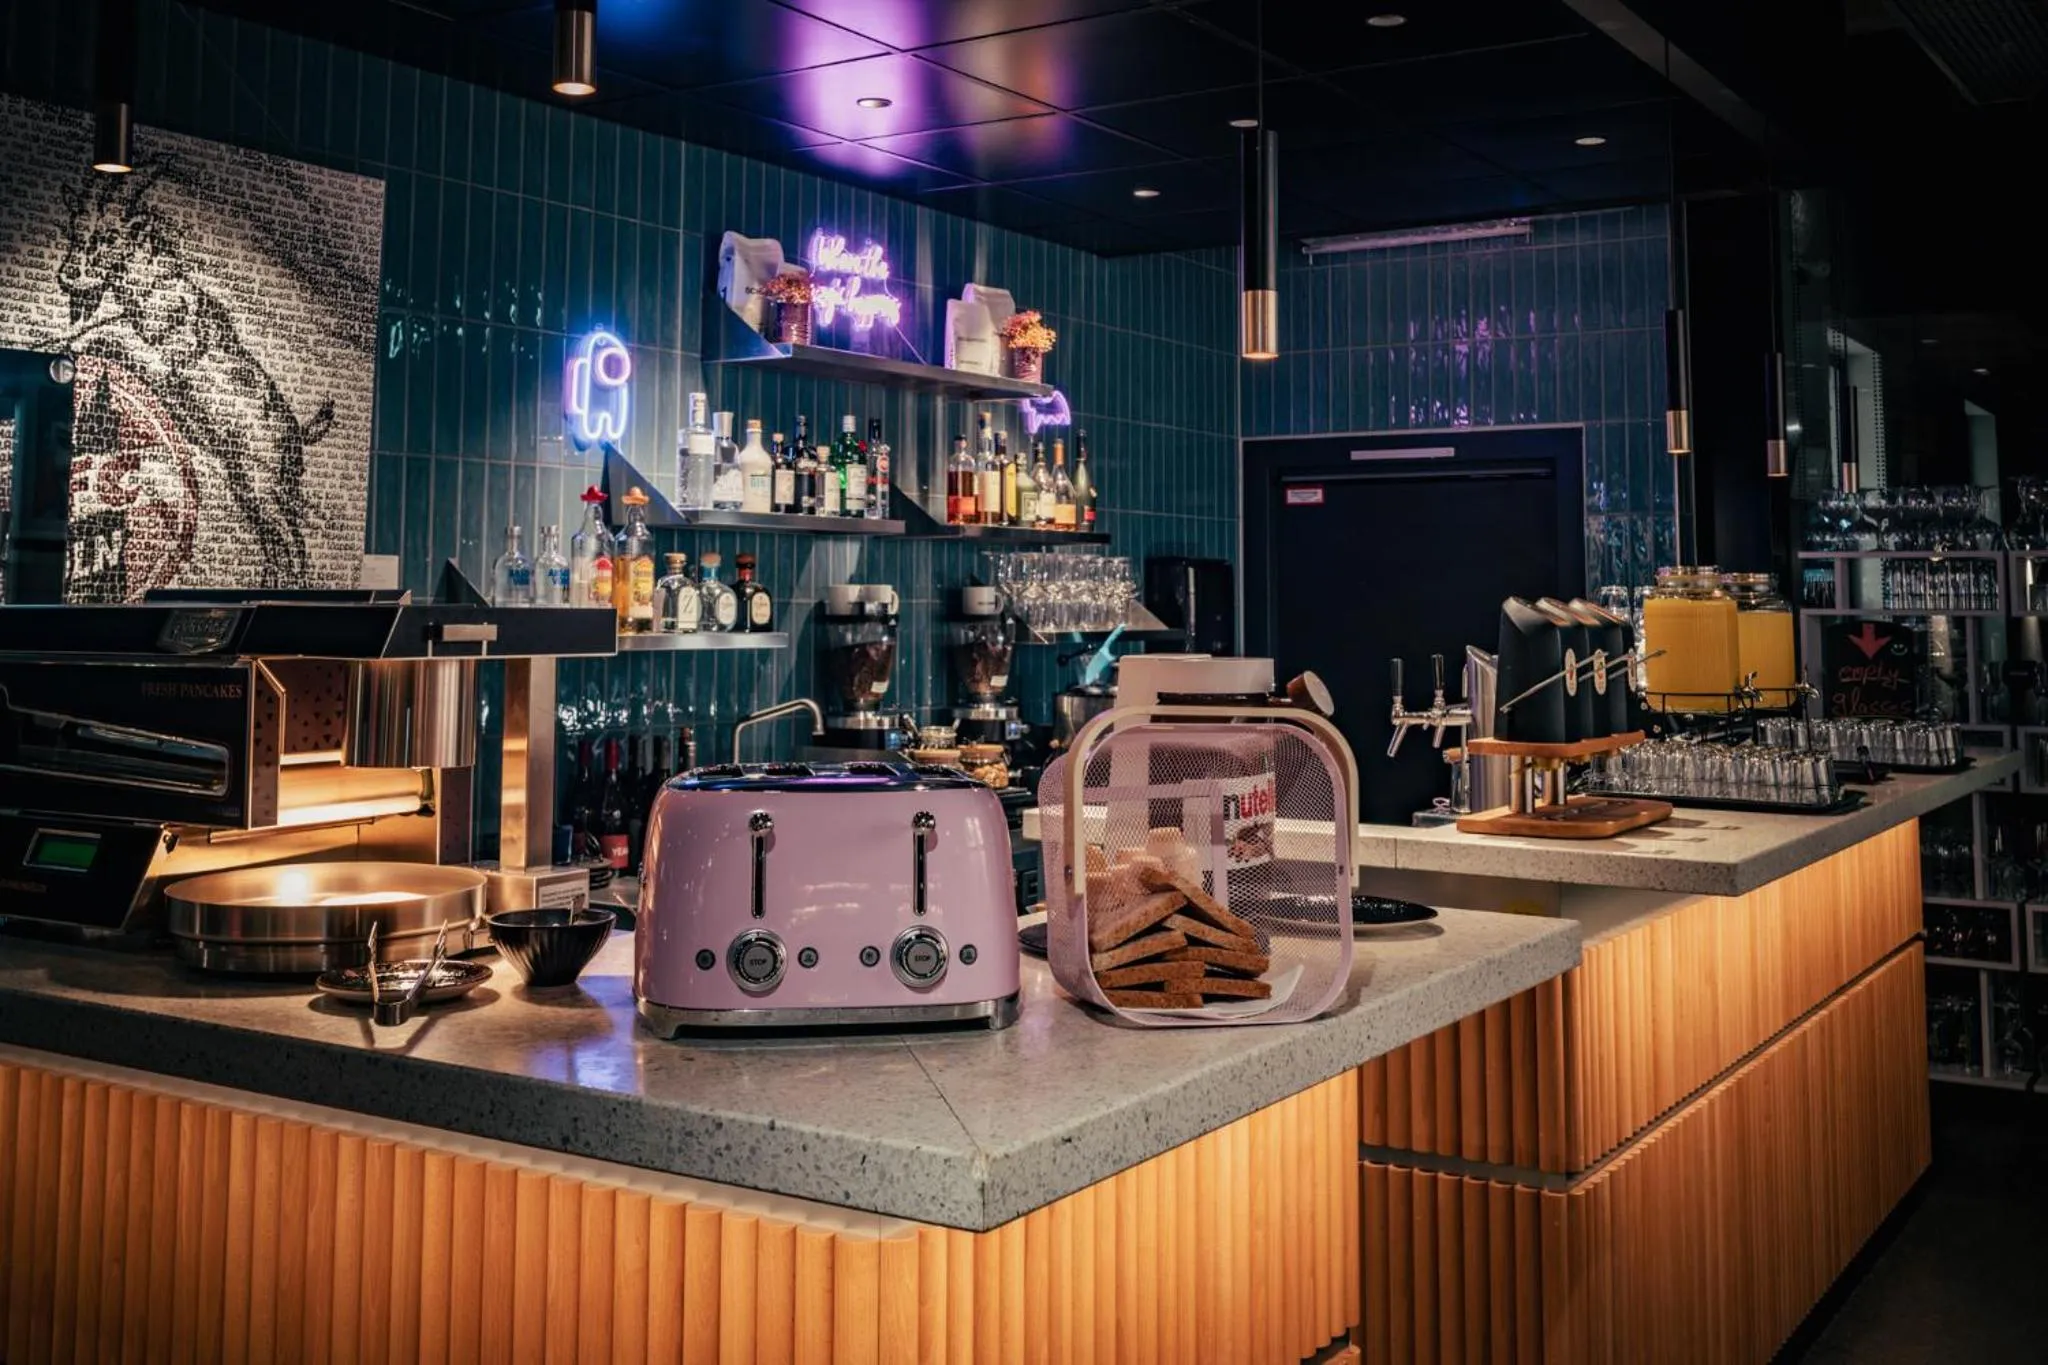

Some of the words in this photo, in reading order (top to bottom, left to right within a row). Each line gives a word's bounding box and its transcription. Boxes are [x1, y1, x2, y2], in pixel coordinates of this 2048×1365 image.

[141, 682, 177, 697] FRESH
[181, 683, 243, 699] PANCAKES
[749, 958, 768, 967] STOP
[914, 954, 931, 963] STOP
